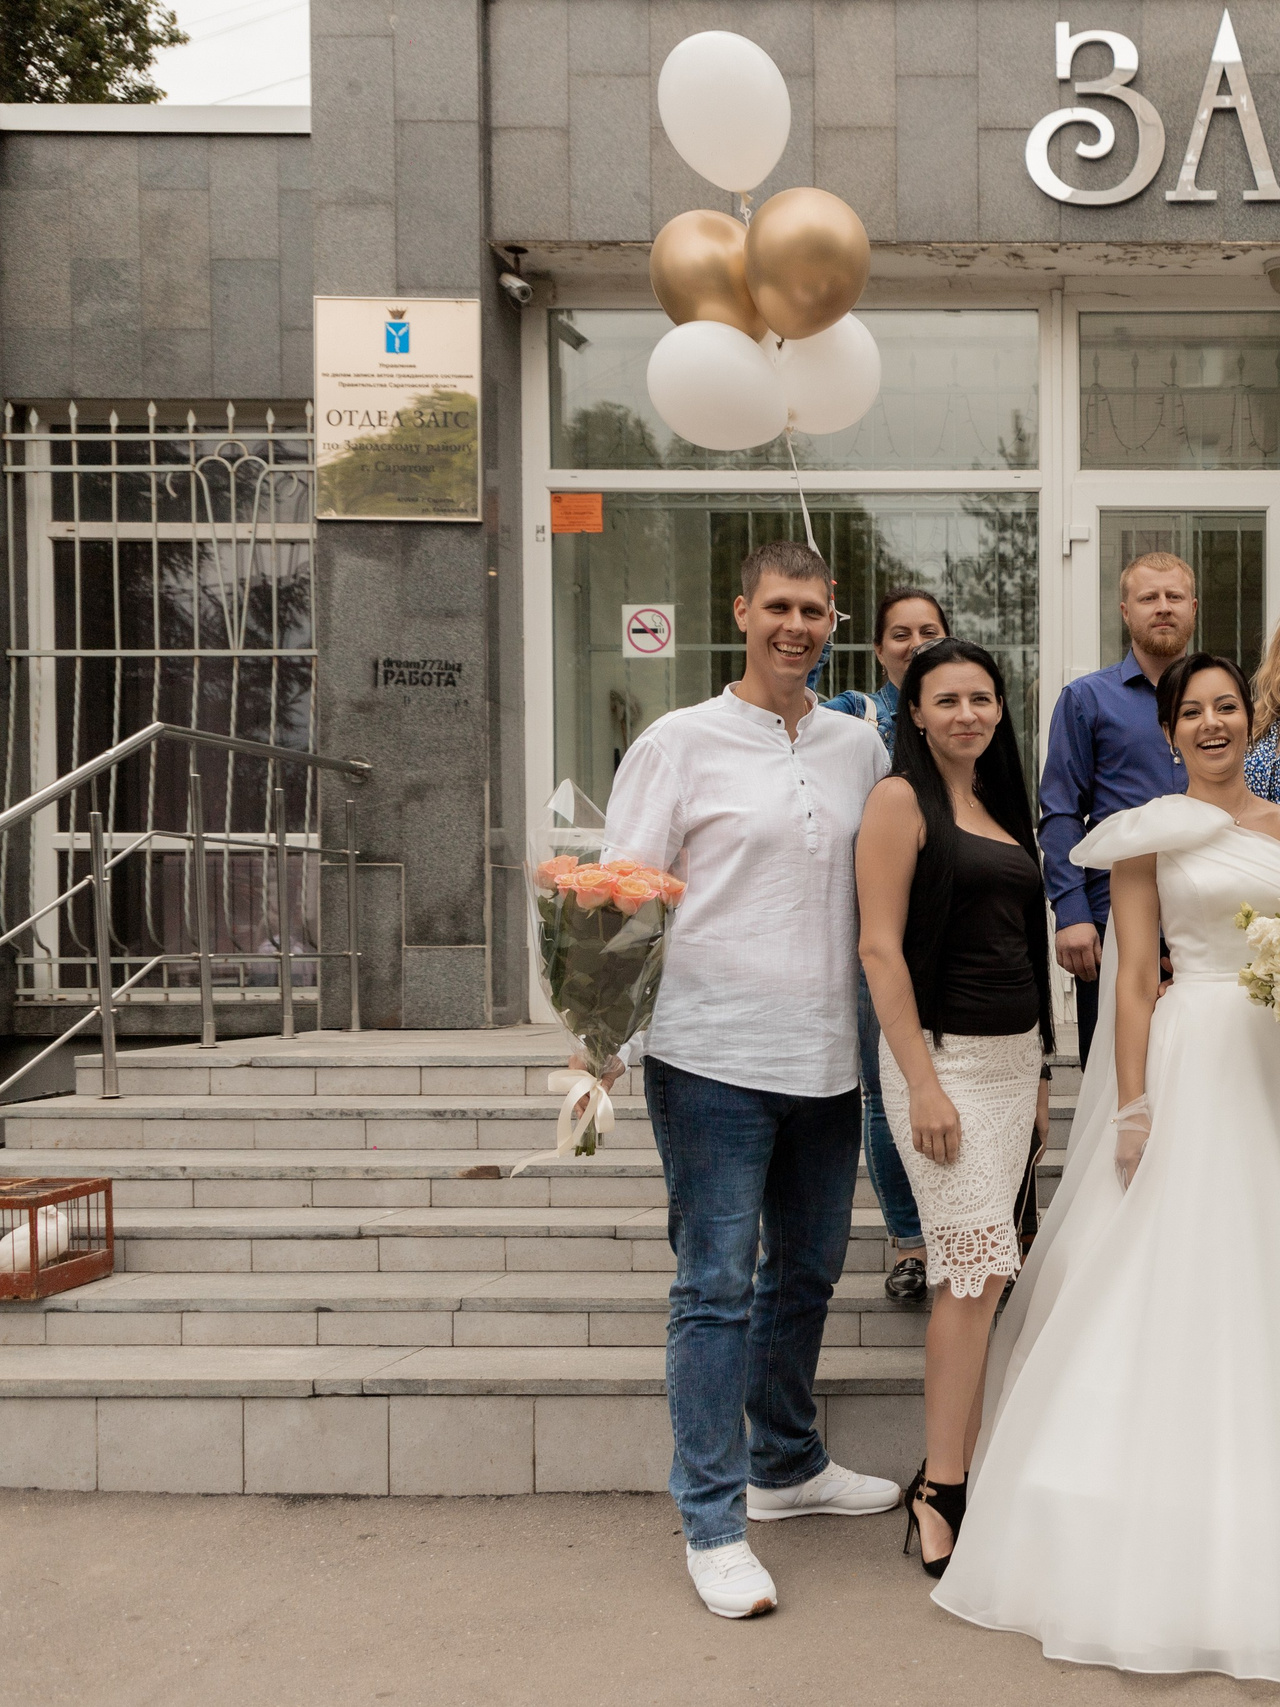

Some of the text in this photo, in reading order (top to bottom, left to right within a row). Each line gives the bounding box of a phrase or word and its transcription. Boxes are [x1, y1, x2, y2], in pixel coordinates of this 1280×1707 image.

[326, 409, 470, 430] ОТДЕЛ ЗАГС
[322, 440, 473, 454] по Заводскому району
[361, 461, 435, 475] г. Саратова
[383, 669, 457, 687] РАБОТА
